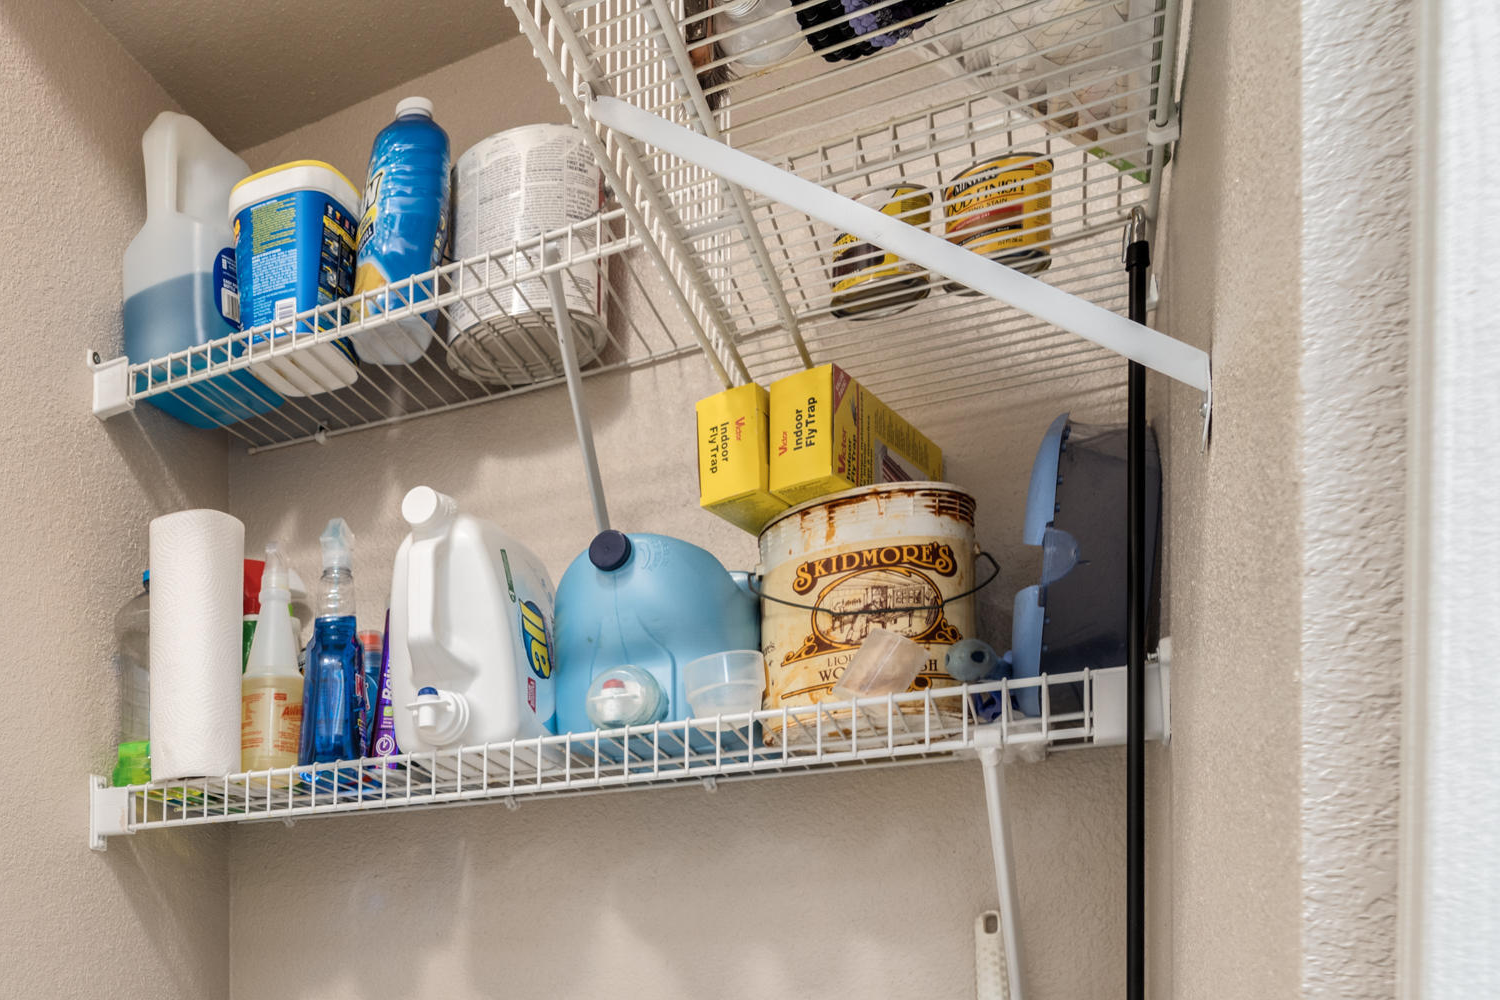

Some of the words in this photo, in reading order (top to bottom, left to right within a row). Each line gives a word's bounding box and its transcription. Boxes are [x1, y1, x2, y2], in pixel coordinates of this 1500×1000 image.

[805, 396, 818, 427] Trap
[708, 426, 718, 444] Fly
[720, 422, 730, 462] Indoor
[793, 409, 803, 451] Indoor
[805, 428, 817, 448] Fly
[709, 446, 719, 474] Trap
[793, 542, 953, 593] SKIDMORE'S
[519, 598, 551, 680] all
